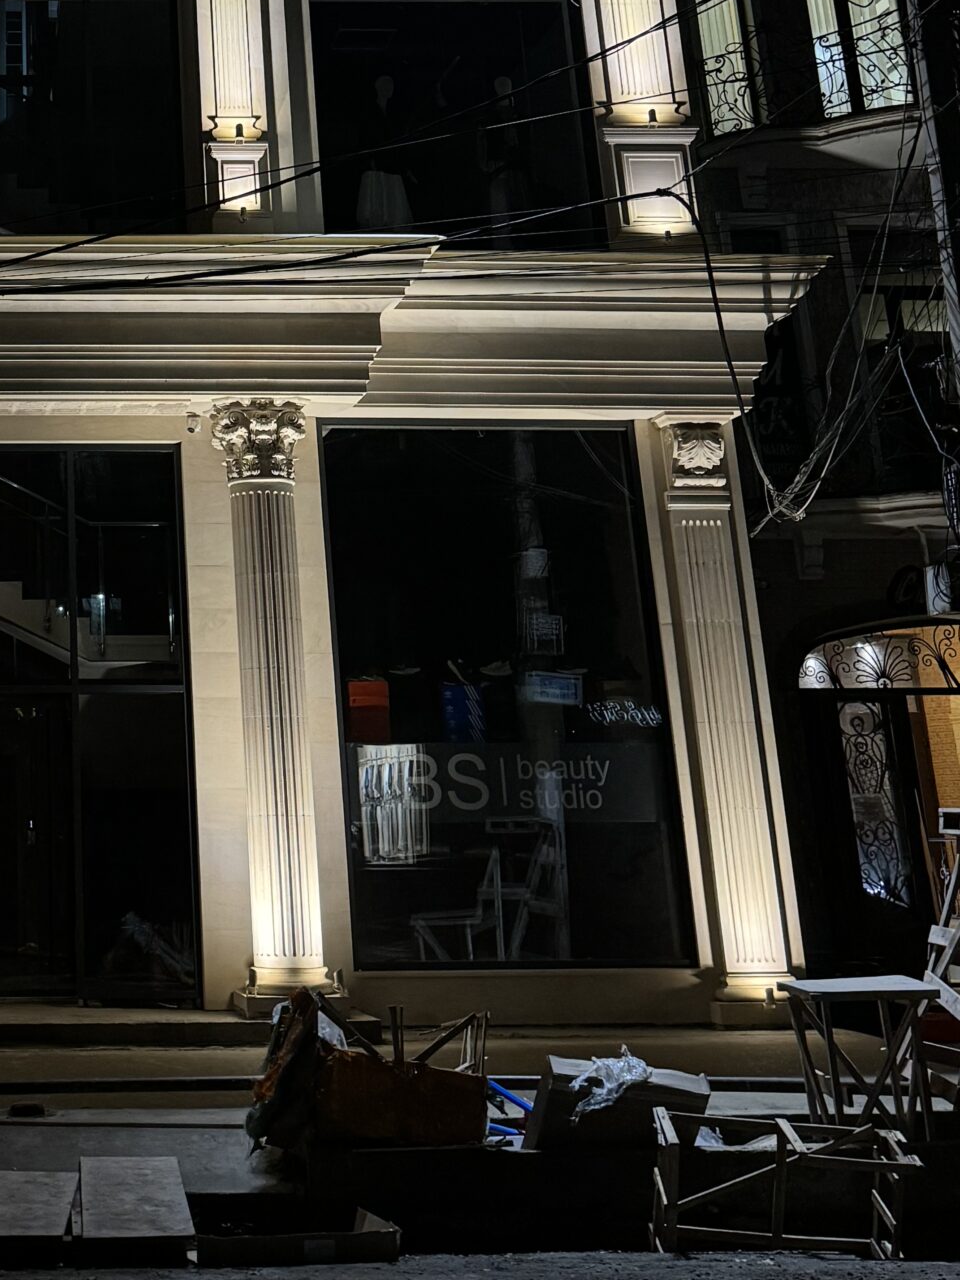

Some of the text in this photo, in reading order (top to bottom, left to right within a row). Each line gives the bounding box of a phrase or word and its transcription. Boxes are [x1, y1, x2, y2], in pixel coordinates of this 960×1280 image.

[409, 753, 489, 811] BS
[516, 754, 610, 786] beauty
[519, 783, 603, 809] studio
